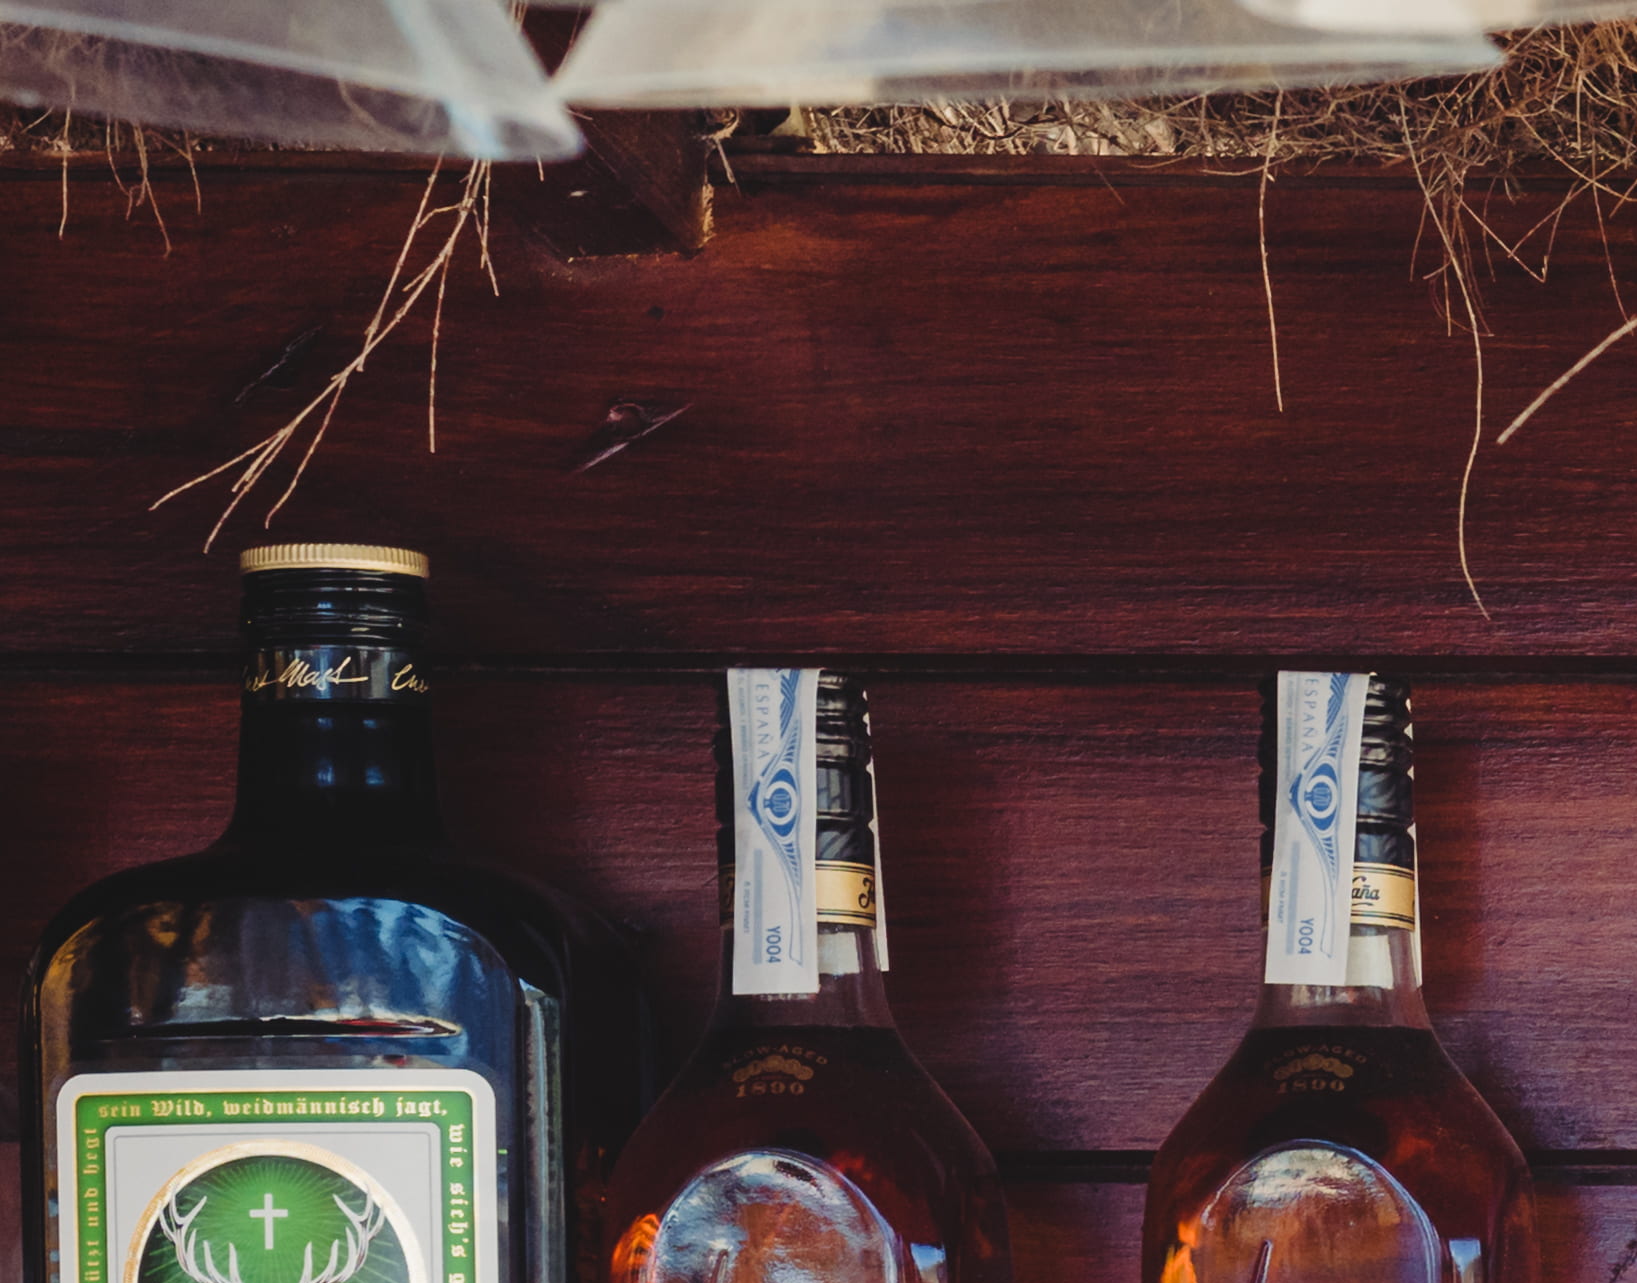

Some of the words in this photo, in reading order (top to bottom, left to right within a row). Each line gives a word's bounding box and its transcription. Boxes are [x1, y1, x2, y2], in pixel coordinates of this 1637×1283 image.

[754, 683, 774, 760] ESPAÑA
[1302, 678, 1319, 753] ESPAÑA
[765, 925, 782, 964] Y004
[1297, 917, 1315, 956] Y004
[99, 1102, 141, 1117] sein
[152, 1100, 212, 1118] Wild,
[223, 1097, 385, 1117] weidmännisch
[396, 1097, 448, 1117] jagt,
[736, 1081, 806, 1099] 1890
[83, 1129, 100, 1175] hegt
[448, 1124, 468, 1168] wie
[83, 1187, 99, 1227] und
